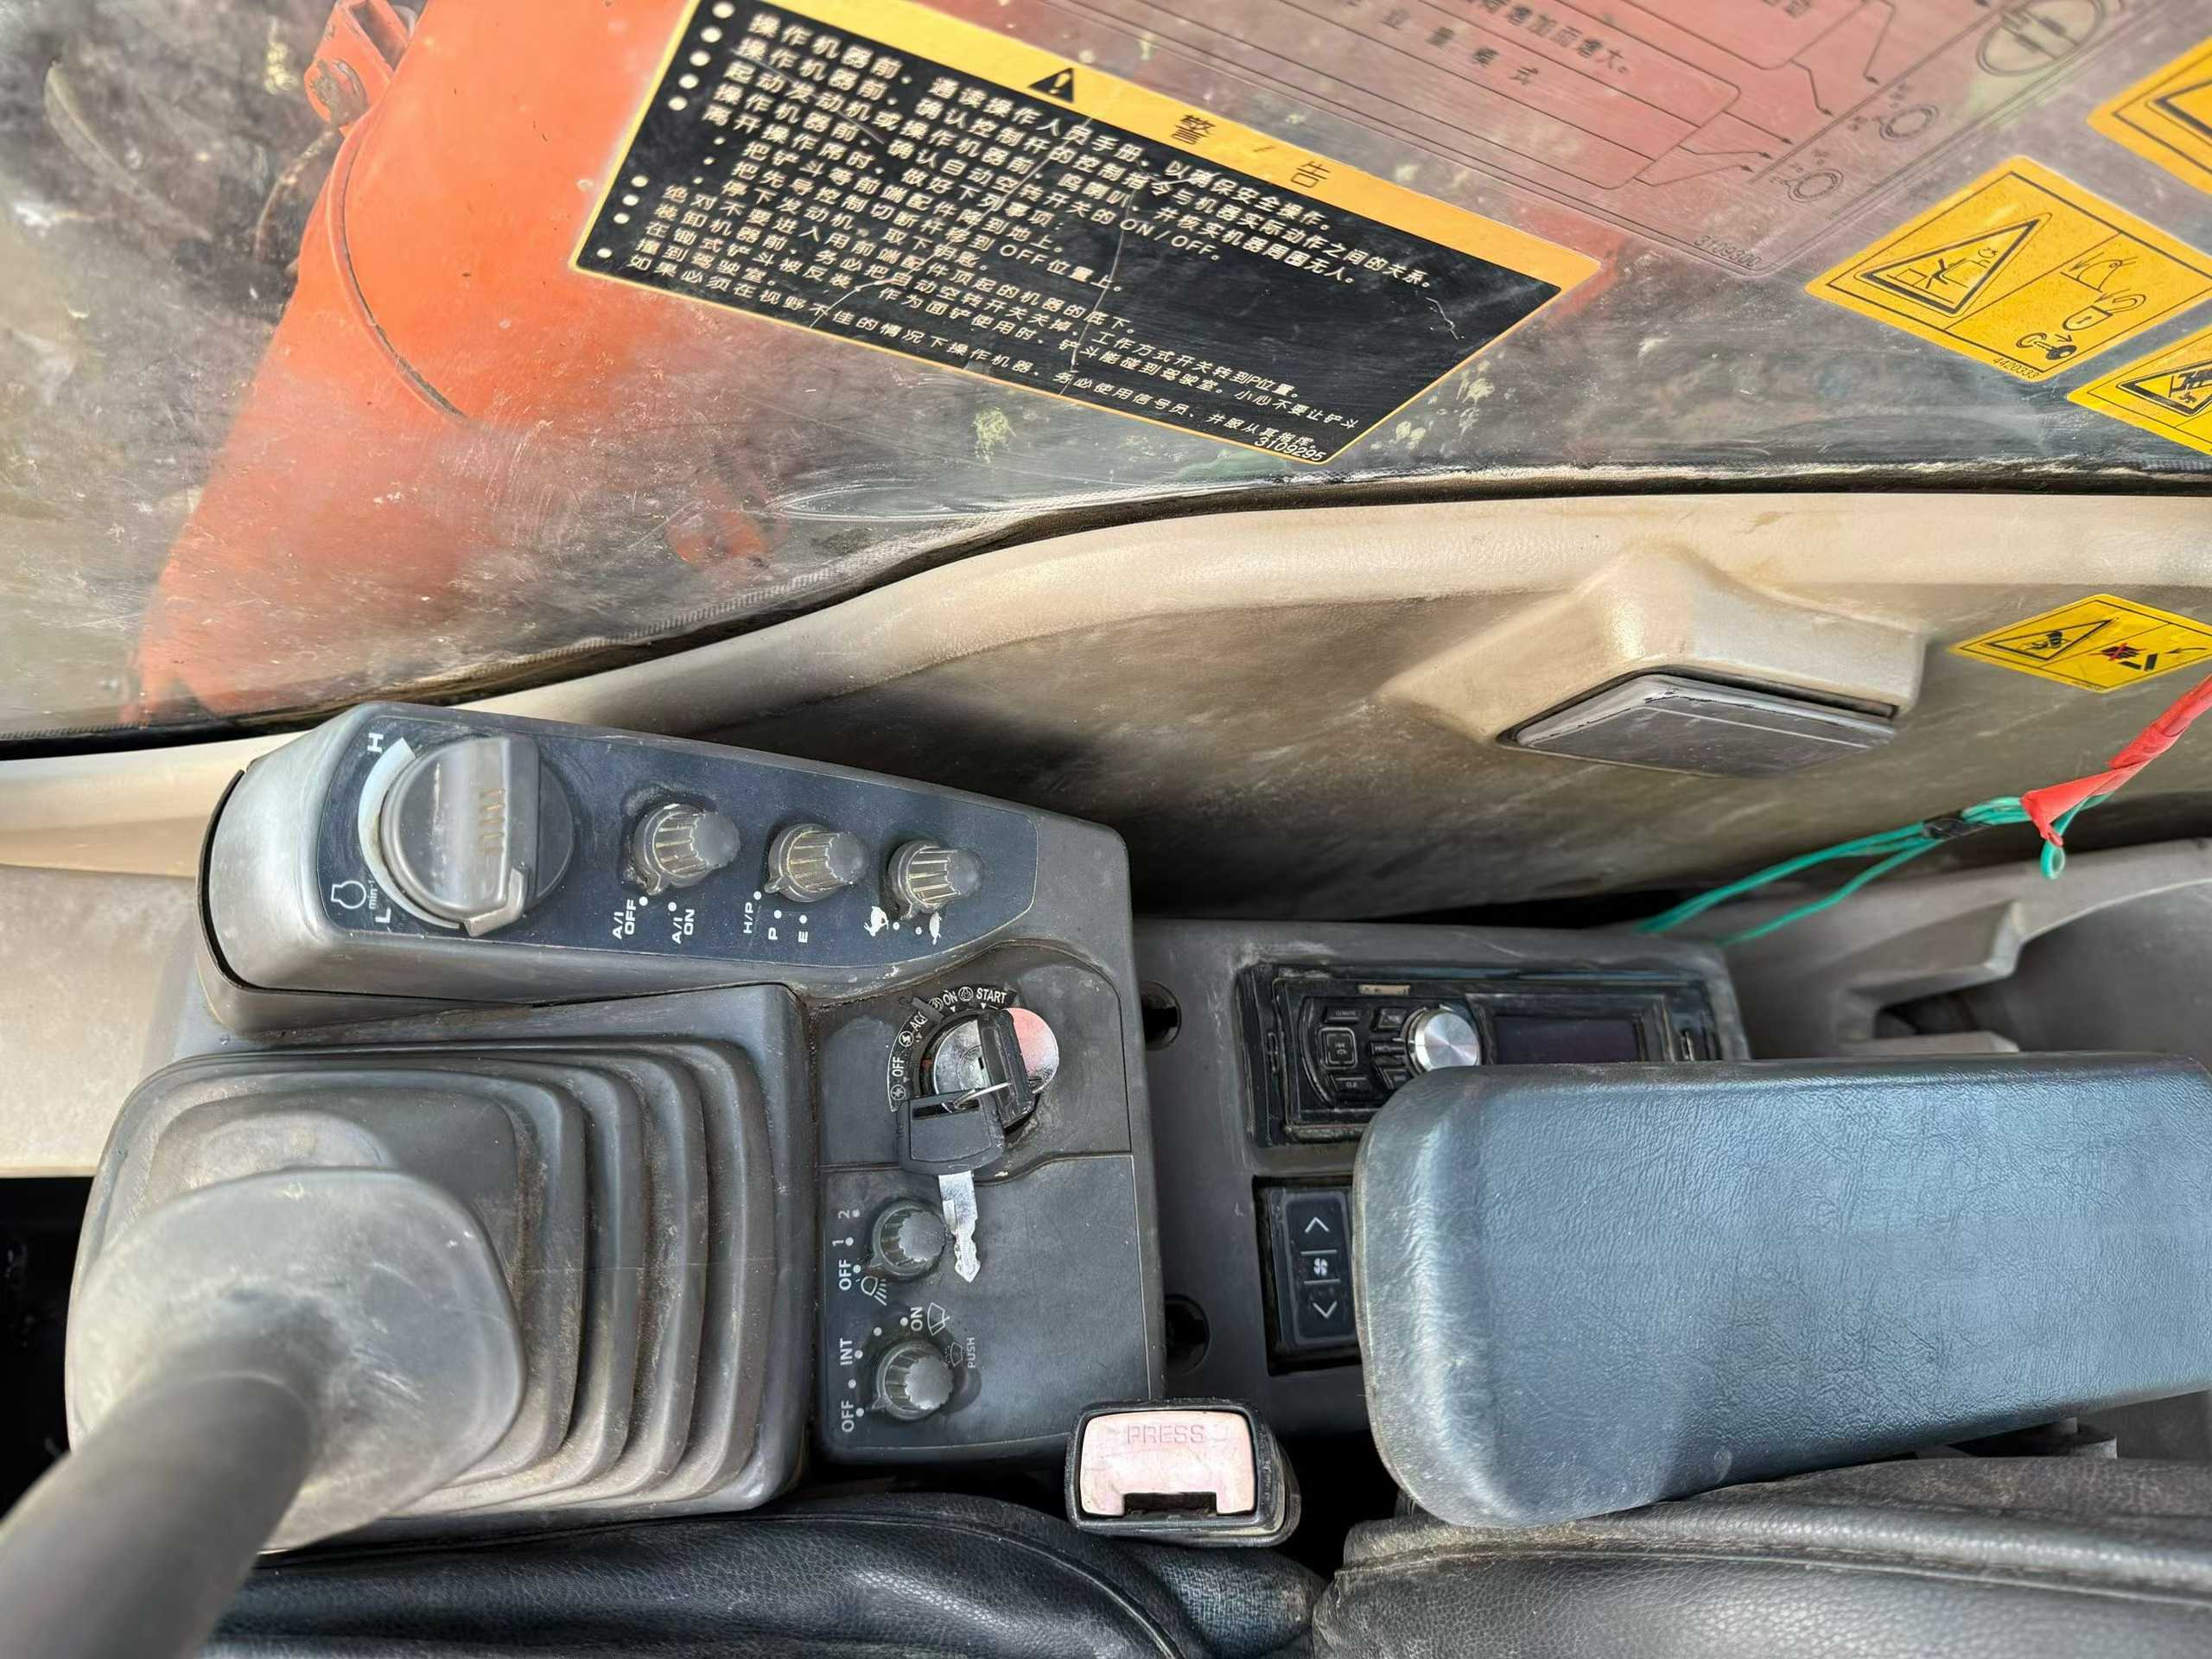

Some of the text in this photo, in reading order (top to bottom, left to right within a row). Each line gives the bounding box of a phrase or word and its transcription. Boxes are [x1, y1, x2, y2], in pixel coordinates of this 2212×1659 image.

[635, 238, 776, 285] 撞到驾驶室。
[1254, 436, 1326, 461] 3109295
[366, 732, 385, 754] H
[375, 909, 391, 925] L
[611, 911, 625, 940] A/I
[624, 899, 637, 936] OFF
[683, 908, 696, 936] ON
[742, 901, 754, 934] H/P
[671, 917, 683, 944] A/I
[768, 928, 779, 941] P
[798, 931, 808, 944] E
[943, 989, 958, 1006] ON
[976, 988, 1008, 1004] START
[891, 1057, 905, 1077] OFF
[837, 1209, 850, 1219] 2
[839, 1258, 852, 1290] OFF
[910, 1306, 923, 1332] ON
[840, 1338, 853, 1365] INT
[967, 1337, 976, 1369] PUSH
[842, 1401, 855, 1433] OFF
[1126, 1424, 1205, 1445] PRESS
